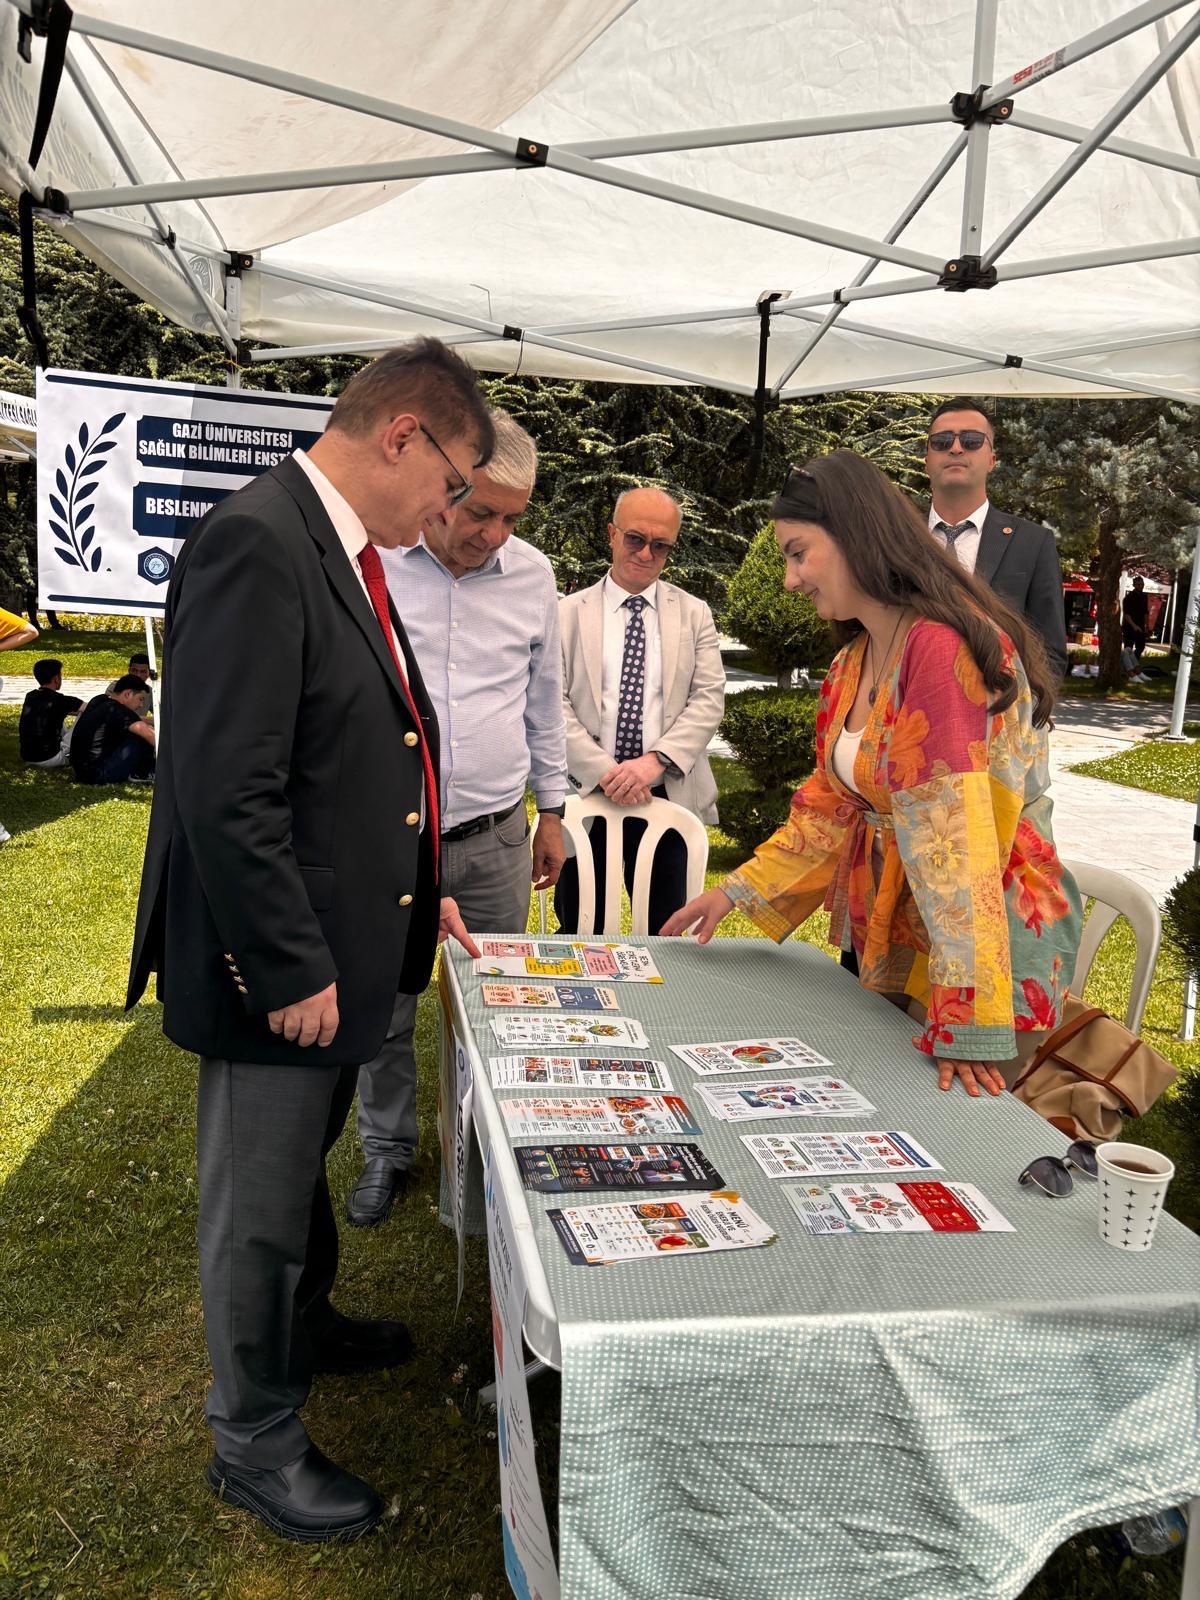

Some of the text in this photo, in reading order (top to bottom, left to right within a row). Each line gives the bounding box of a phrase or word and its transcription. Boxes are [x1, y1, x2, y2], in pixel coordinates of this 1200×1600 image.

[172, 422, 293, 448] GAZİ ÜNİVERSİTESİ
[139, 438, 186, 459] SAĞLIK
[188, 443, 252, 465] BİLİMLERİ
[145, 497, 216, 518] BESLENM
[727, 1211, 750, 1228] MENÜ
